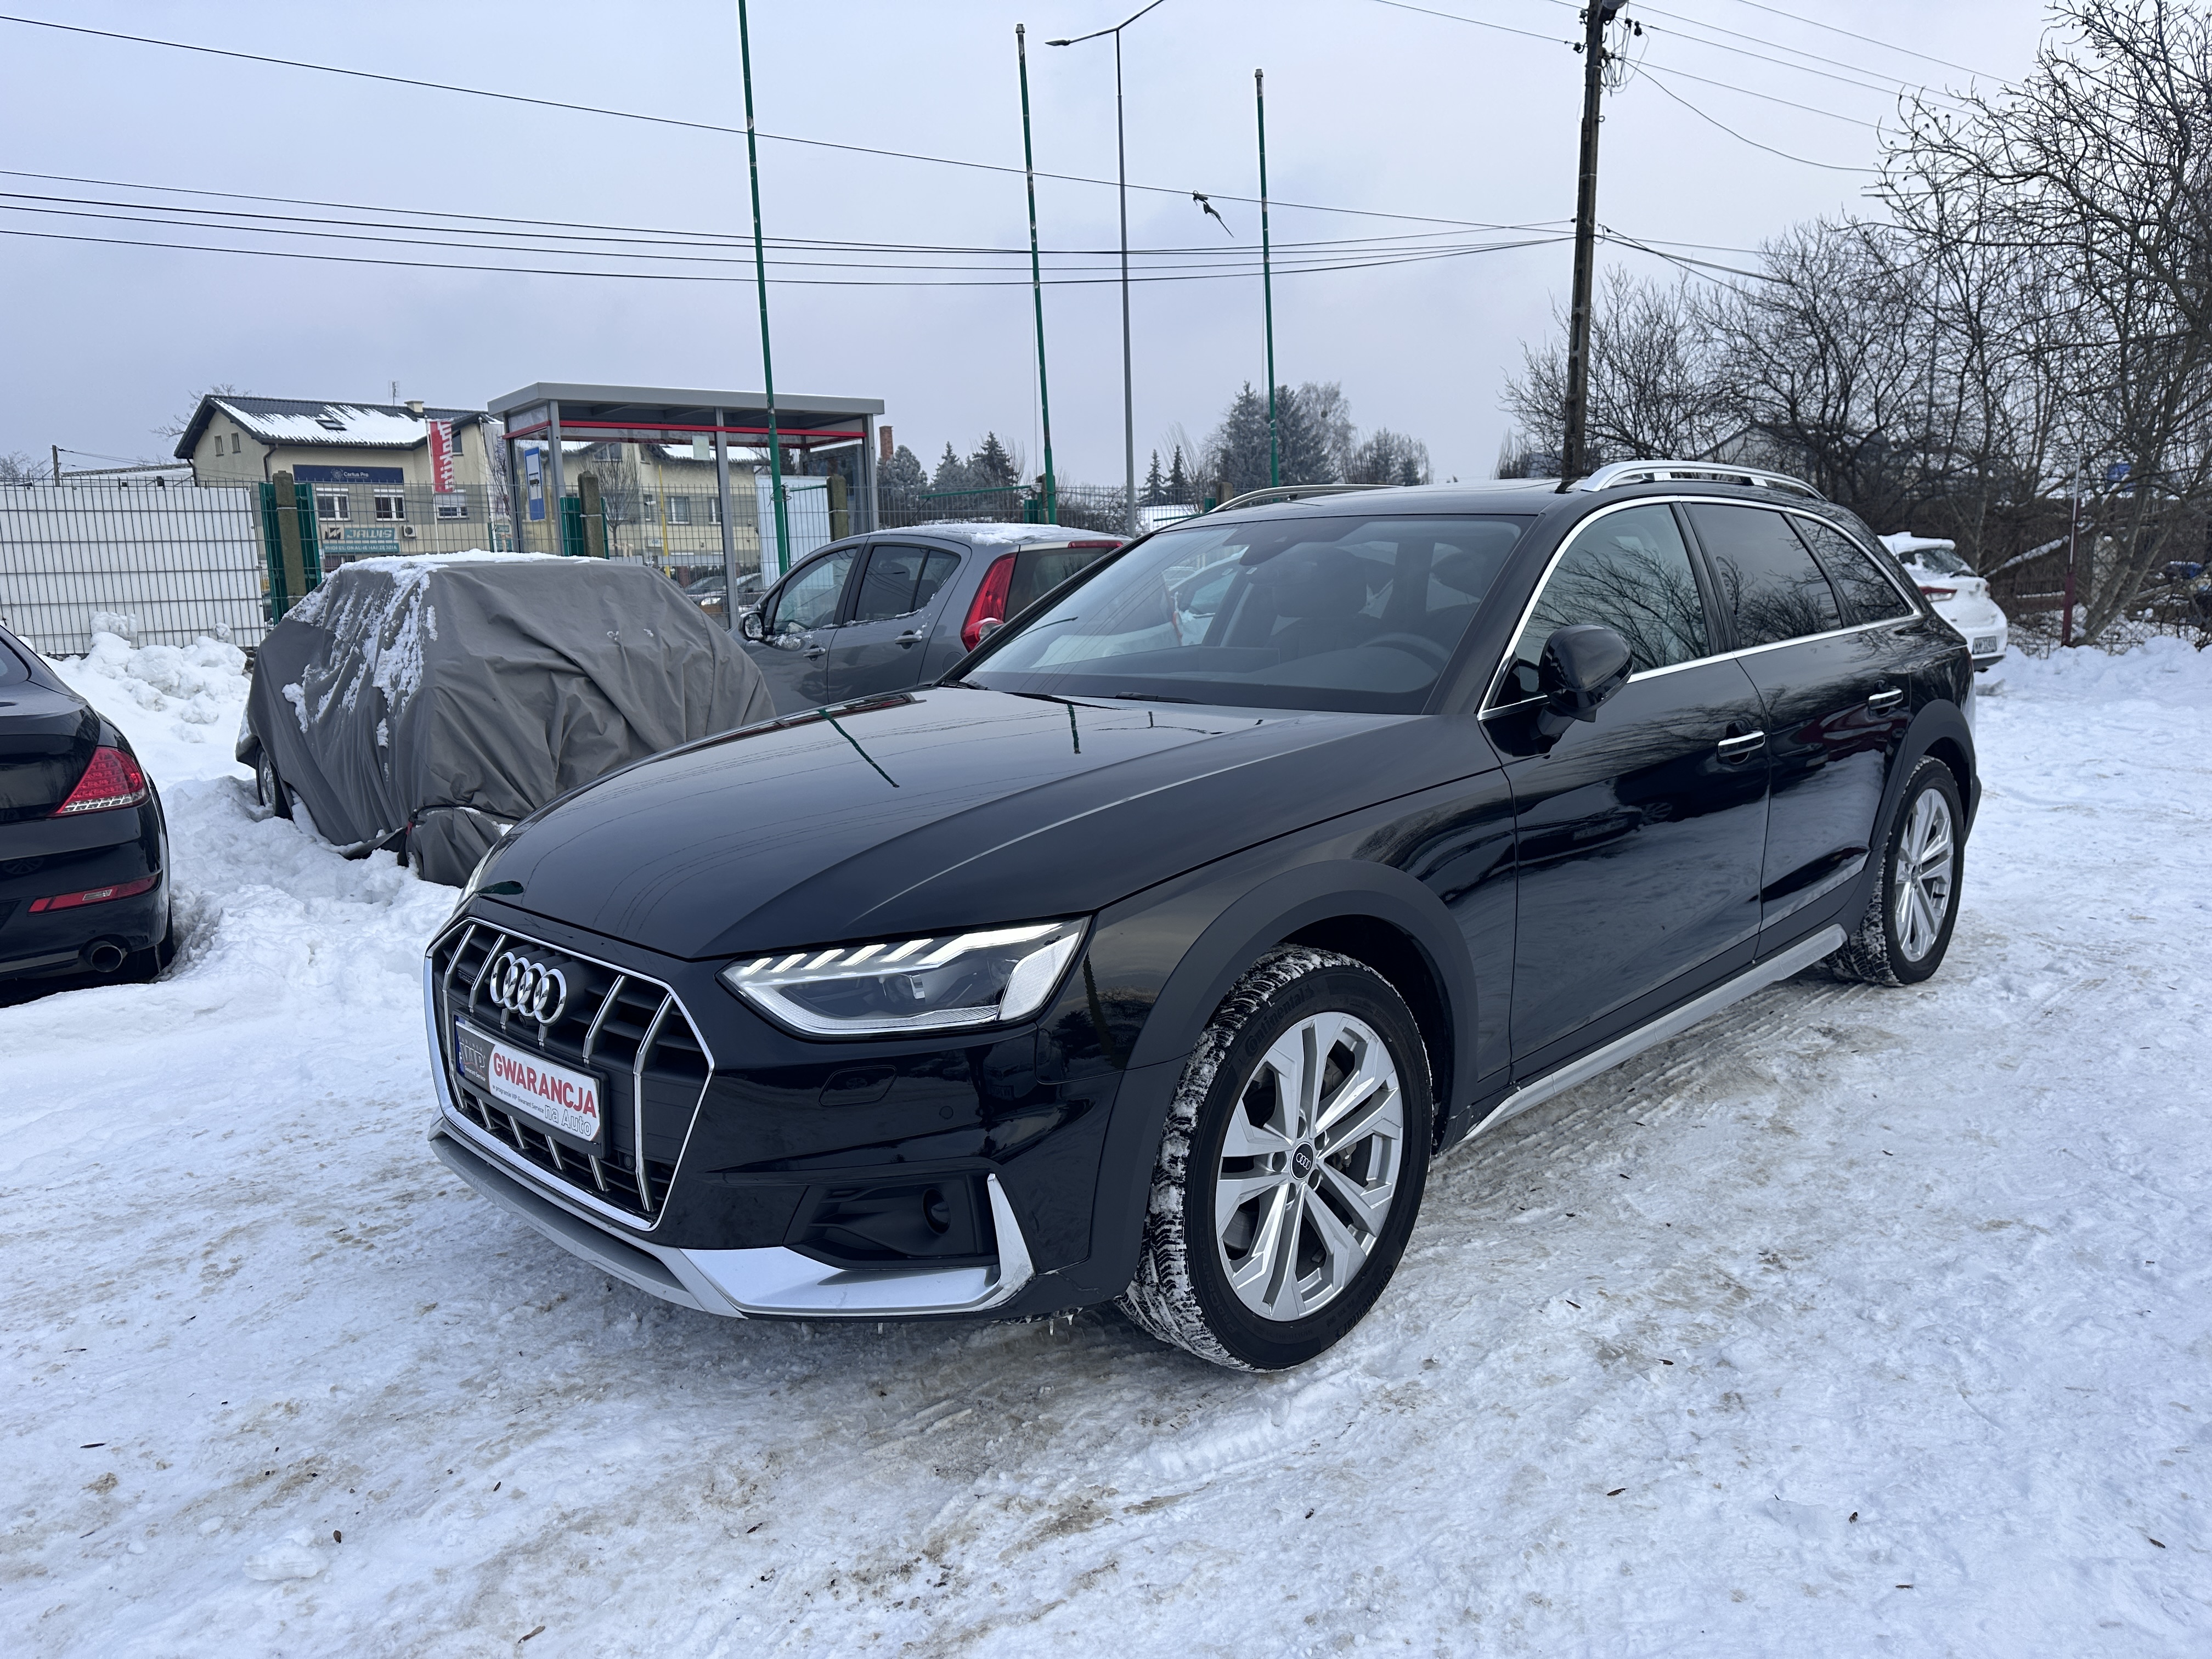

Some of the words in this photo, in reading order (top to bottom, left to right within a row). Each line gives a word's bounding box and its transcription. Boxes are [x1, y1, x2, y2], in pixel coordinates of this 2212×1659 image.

[1245, 988, 1305, 1057] Continental
[459, 1042, 486, 1071] VIP
[493, 1052, 596, 1118] GWARANCJA
[532, 1102, 544, 1114] Service
[545, 1104, 558, 1124] na
[561, 1109, 591, 1137] Auto
[1344, 1264, 1394, 1336] Continental
